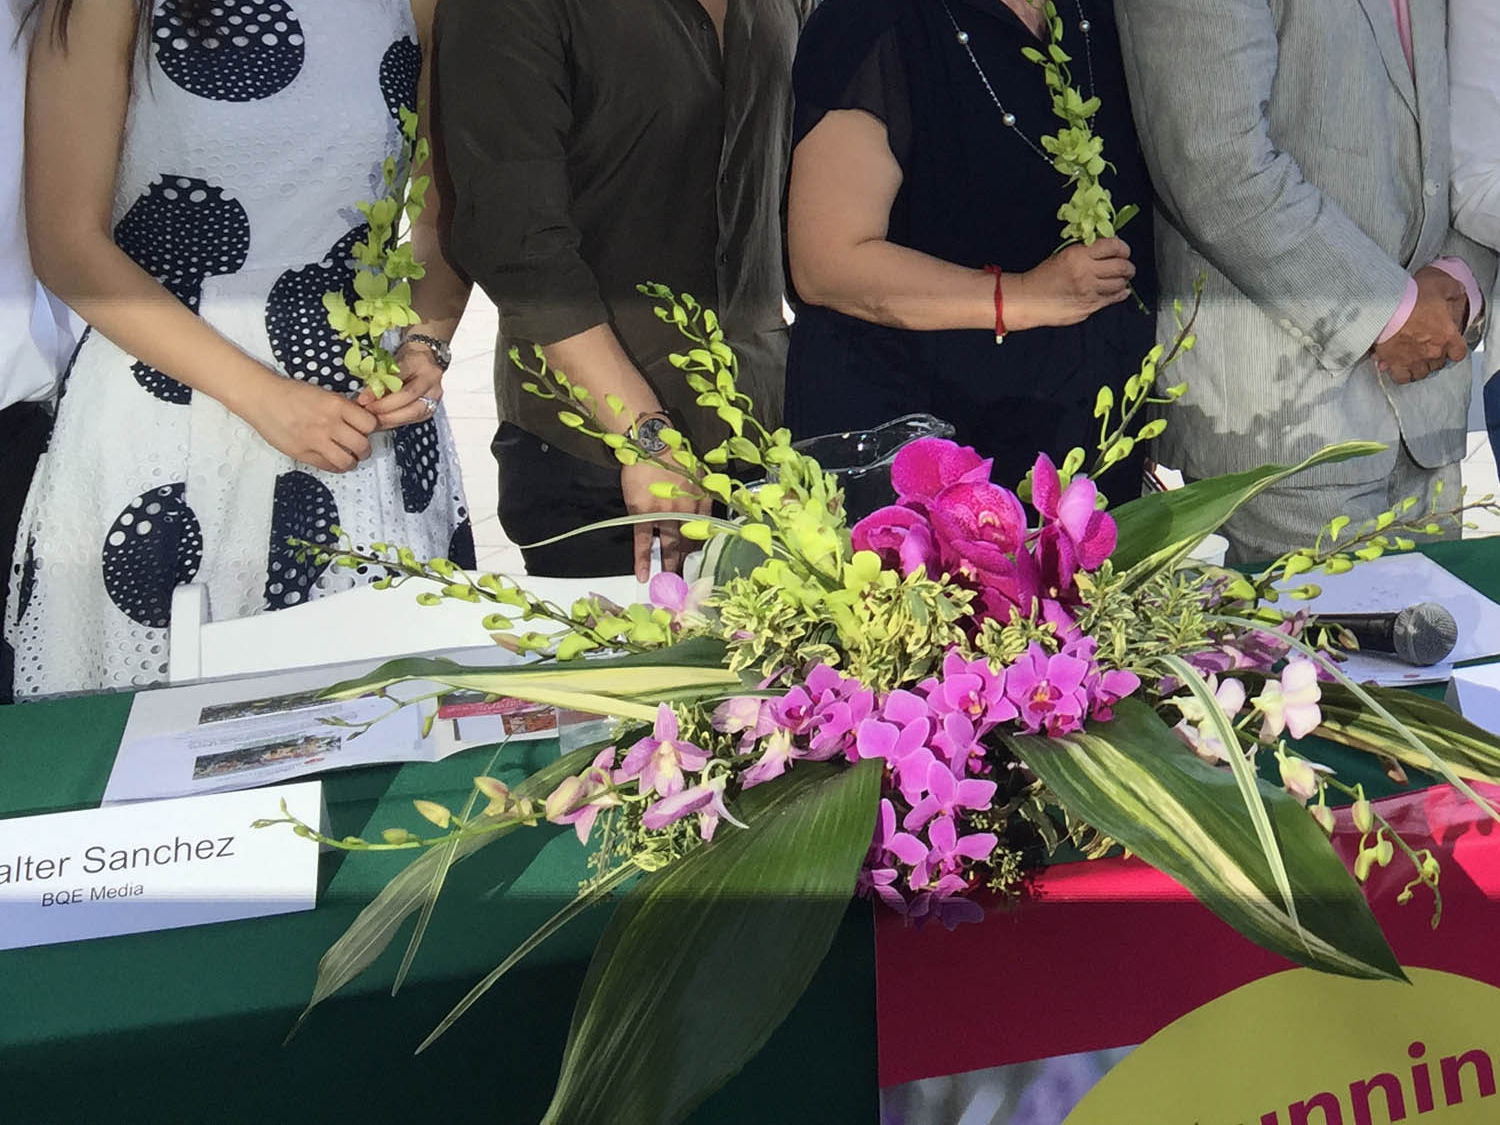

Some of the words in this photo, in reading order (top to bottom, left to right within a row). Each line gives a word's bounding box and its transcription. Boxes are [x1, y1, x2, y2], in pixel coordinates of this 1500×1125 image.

[0, 855, 71, 885] alter
[82, 836, 236, 874] Sanchez
[41, 888, 84, 907] BQE
[90, 882, 144, 901] Media
